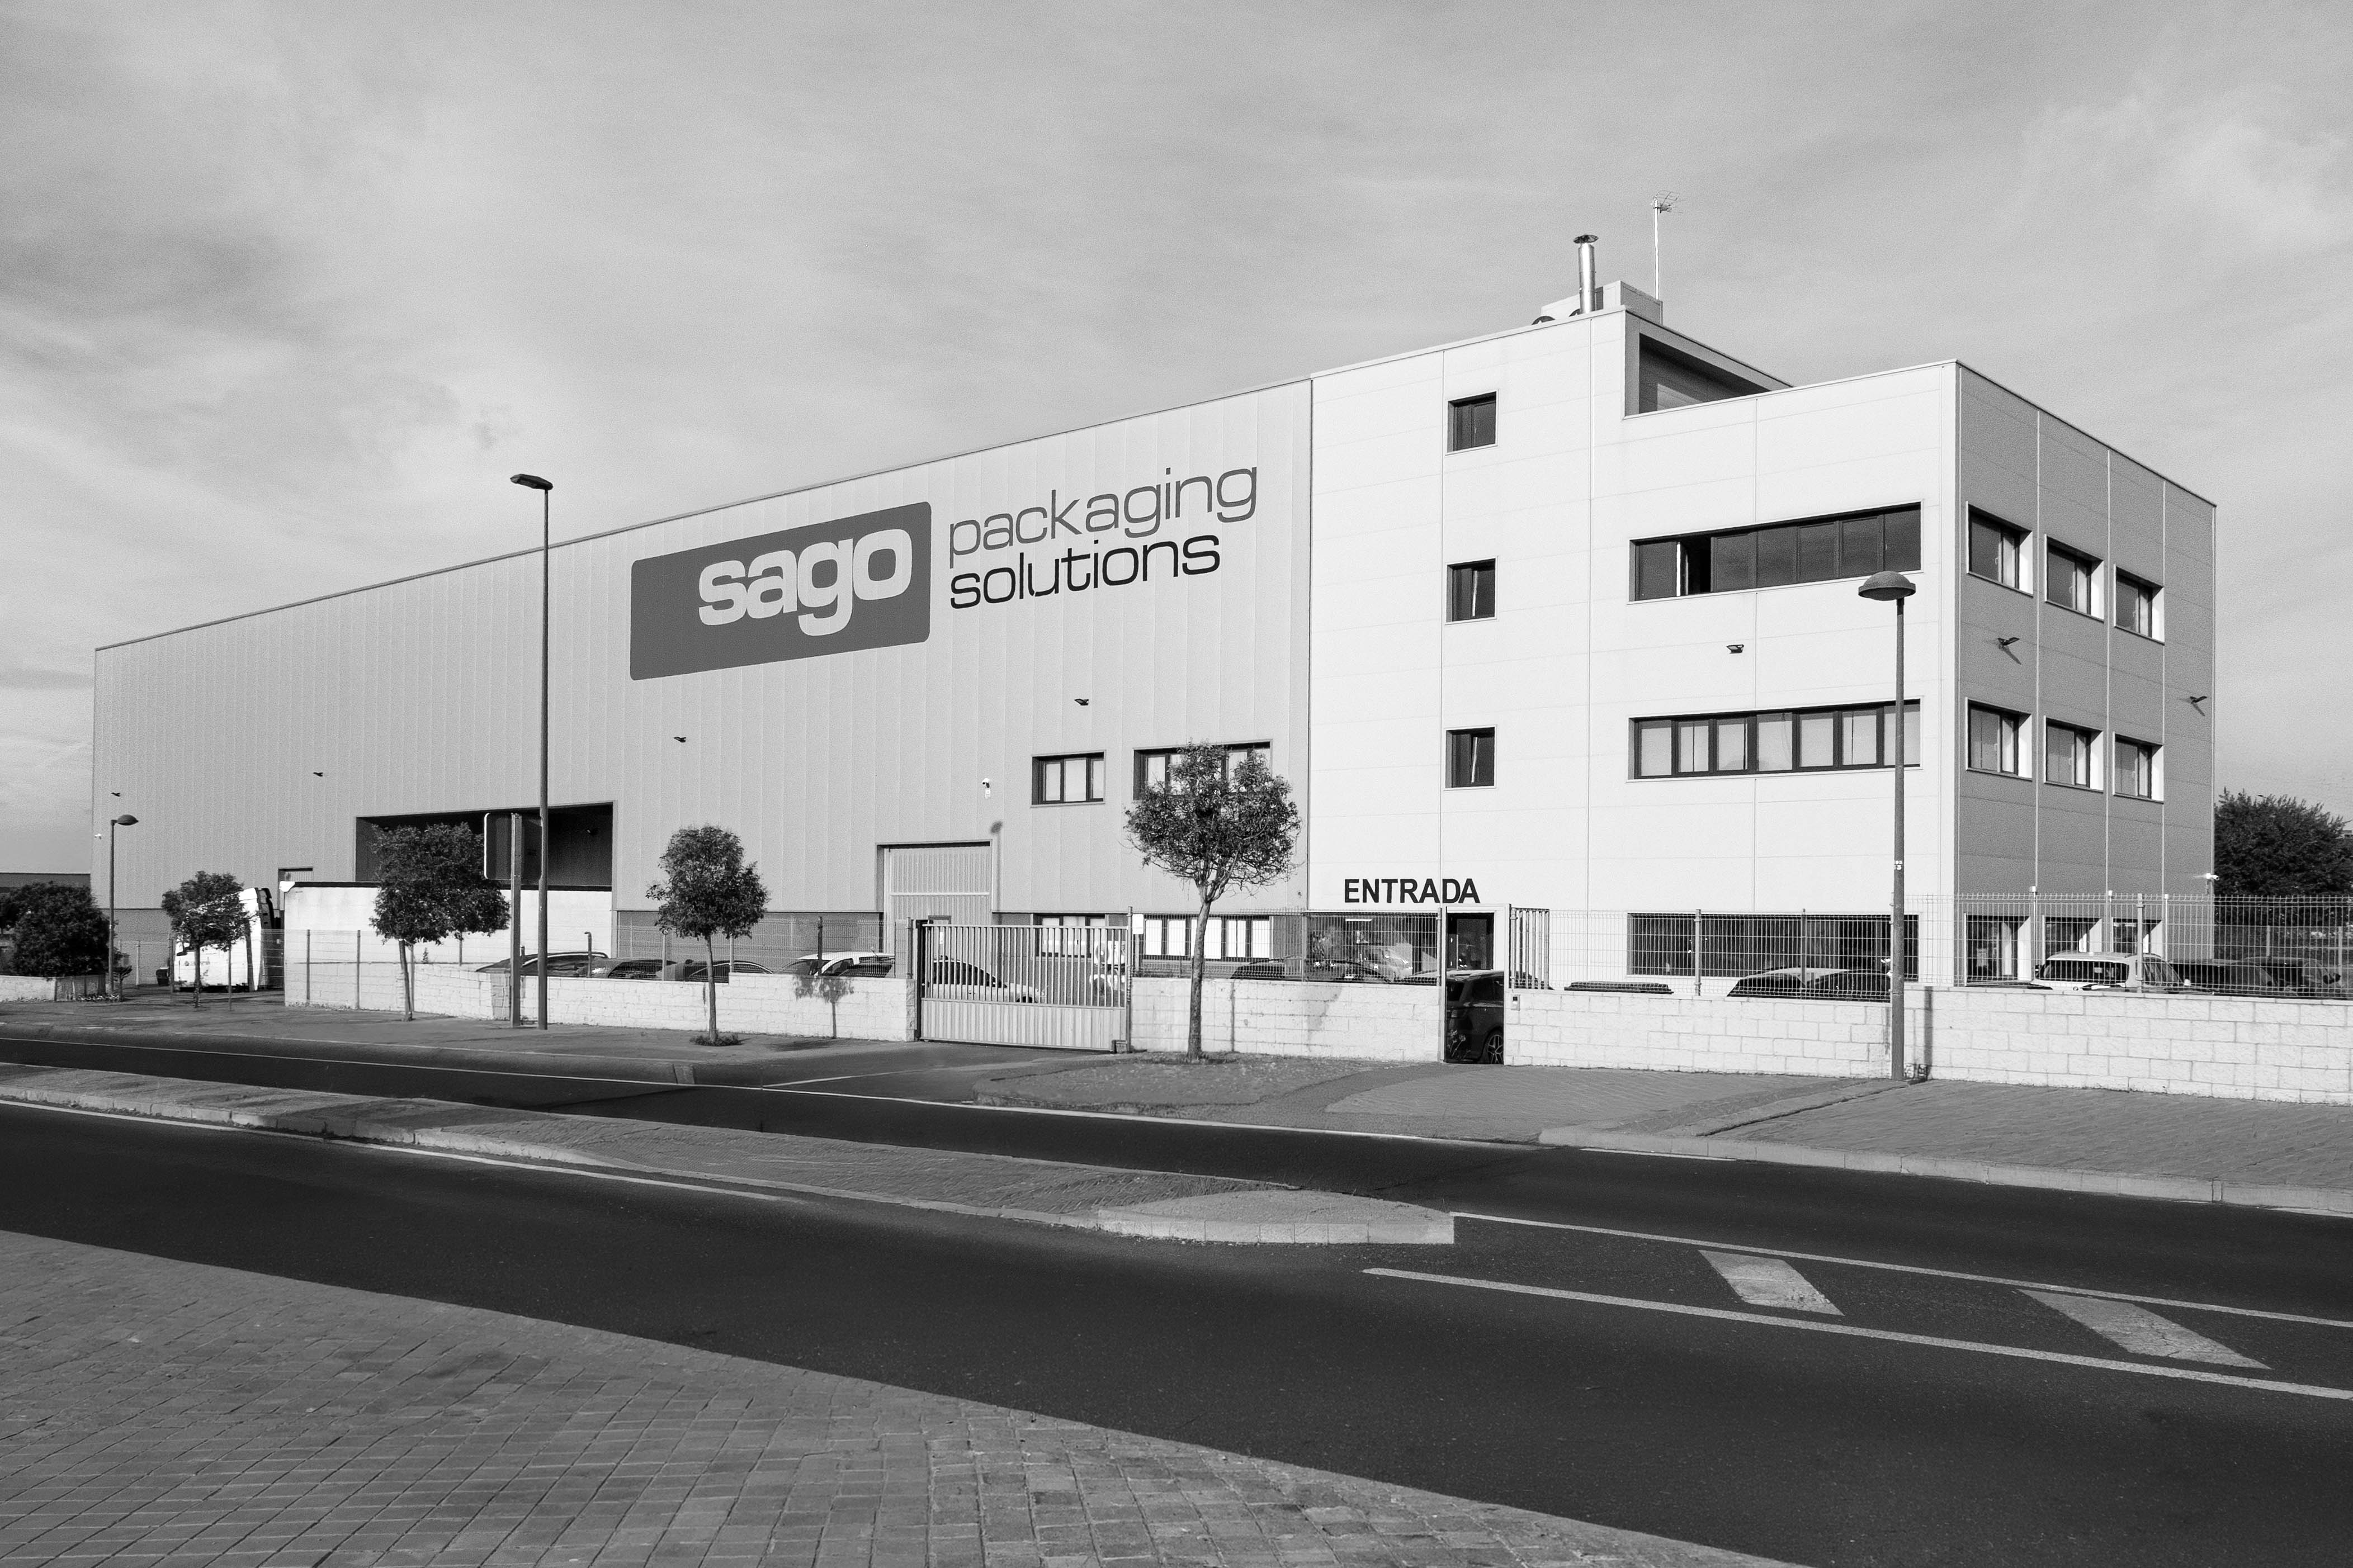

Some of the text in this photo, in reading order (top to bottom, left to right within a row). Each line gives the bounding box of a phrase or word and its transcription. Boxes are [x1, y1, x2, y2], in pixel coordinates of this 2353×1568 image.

[949, 467, 1257, 569] packaging
[698, 528, 913, 636] sago
[950, 534, 1220, 609] solutions
[1344, 878, 1480, 903] ENTRADA
